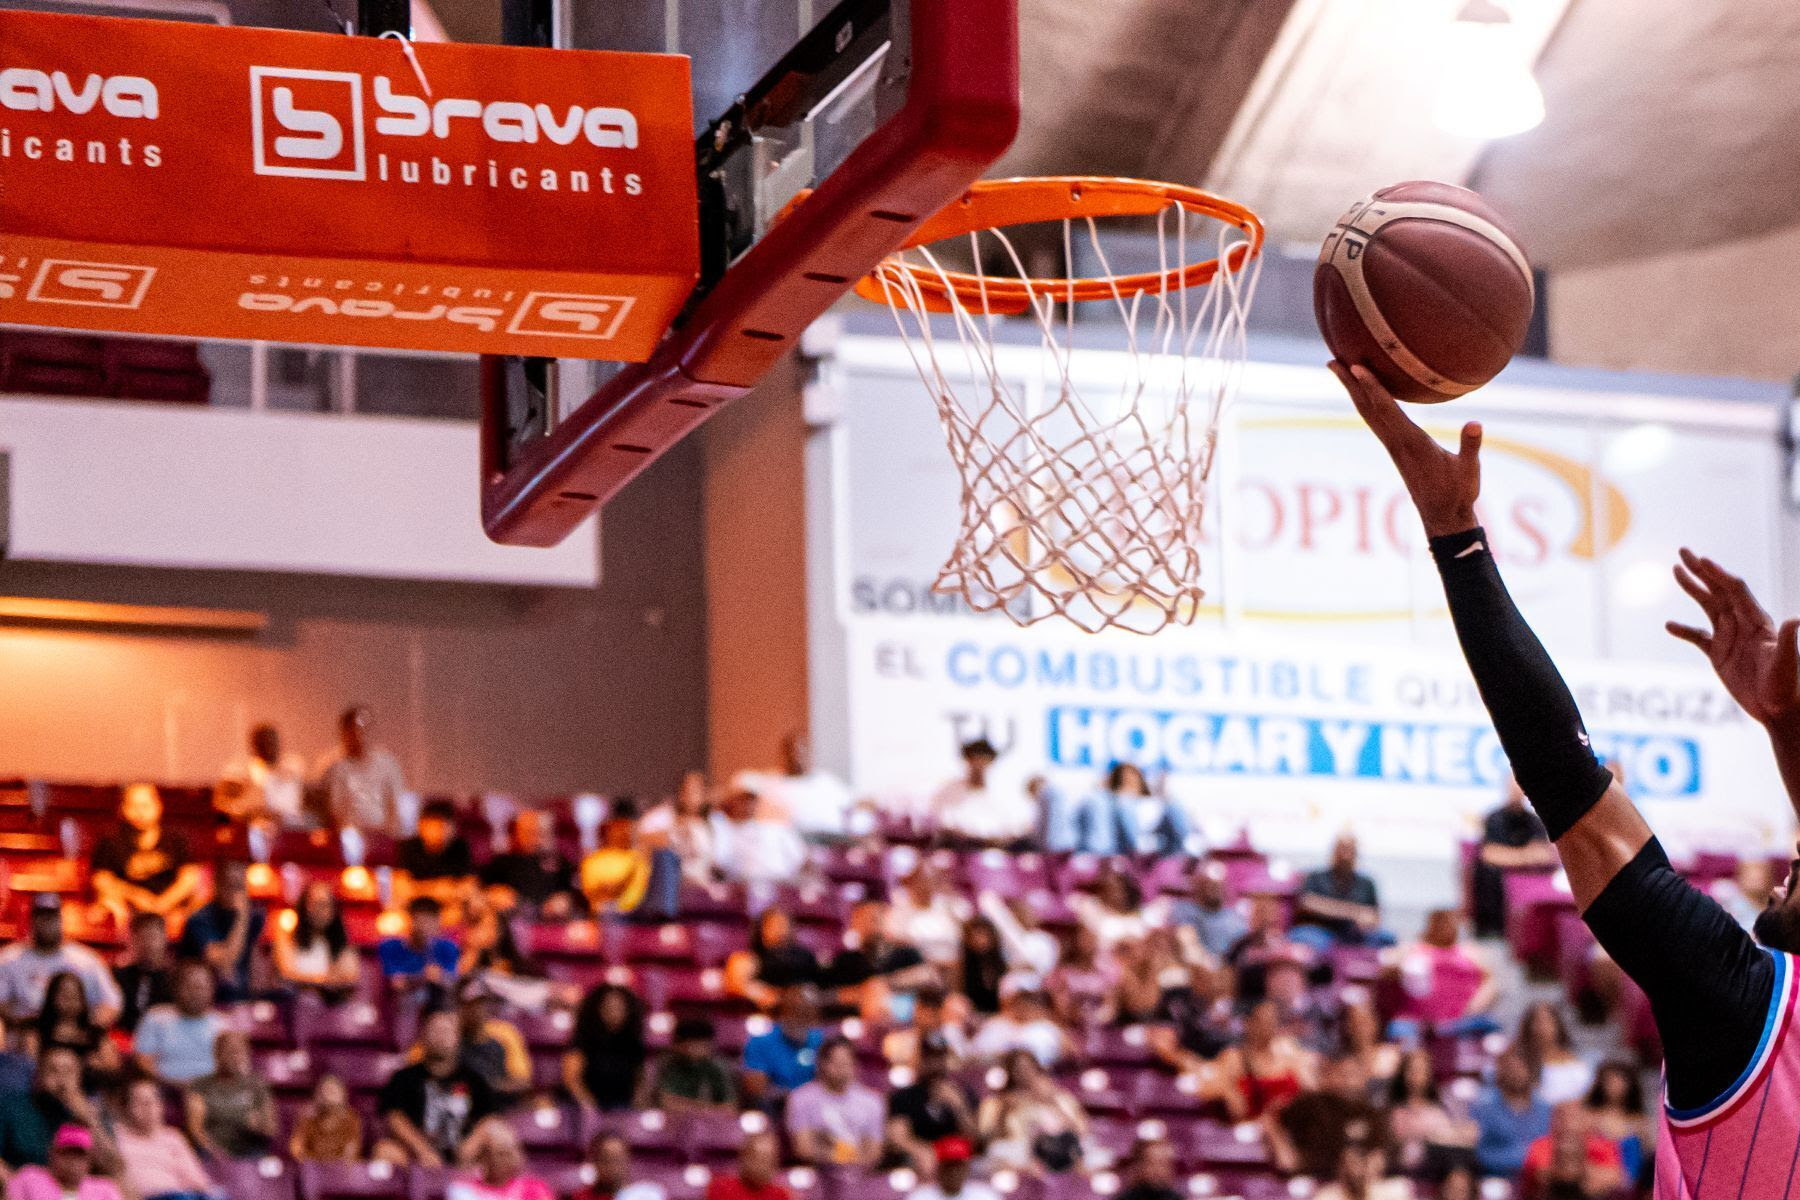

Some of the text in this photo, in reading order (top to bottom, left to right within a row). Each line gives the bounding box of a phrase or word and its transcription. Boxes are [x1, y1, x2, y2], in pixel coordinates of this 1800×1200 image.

[375, 76, 638, 150] brava
[380, 154, 643, 197] lubricants
[946, 640, 1372, 706] COMBUSTIBLE
[1058, 715, 1306, 774] HOGAR
[1318, 724, 1373, 779] Y
